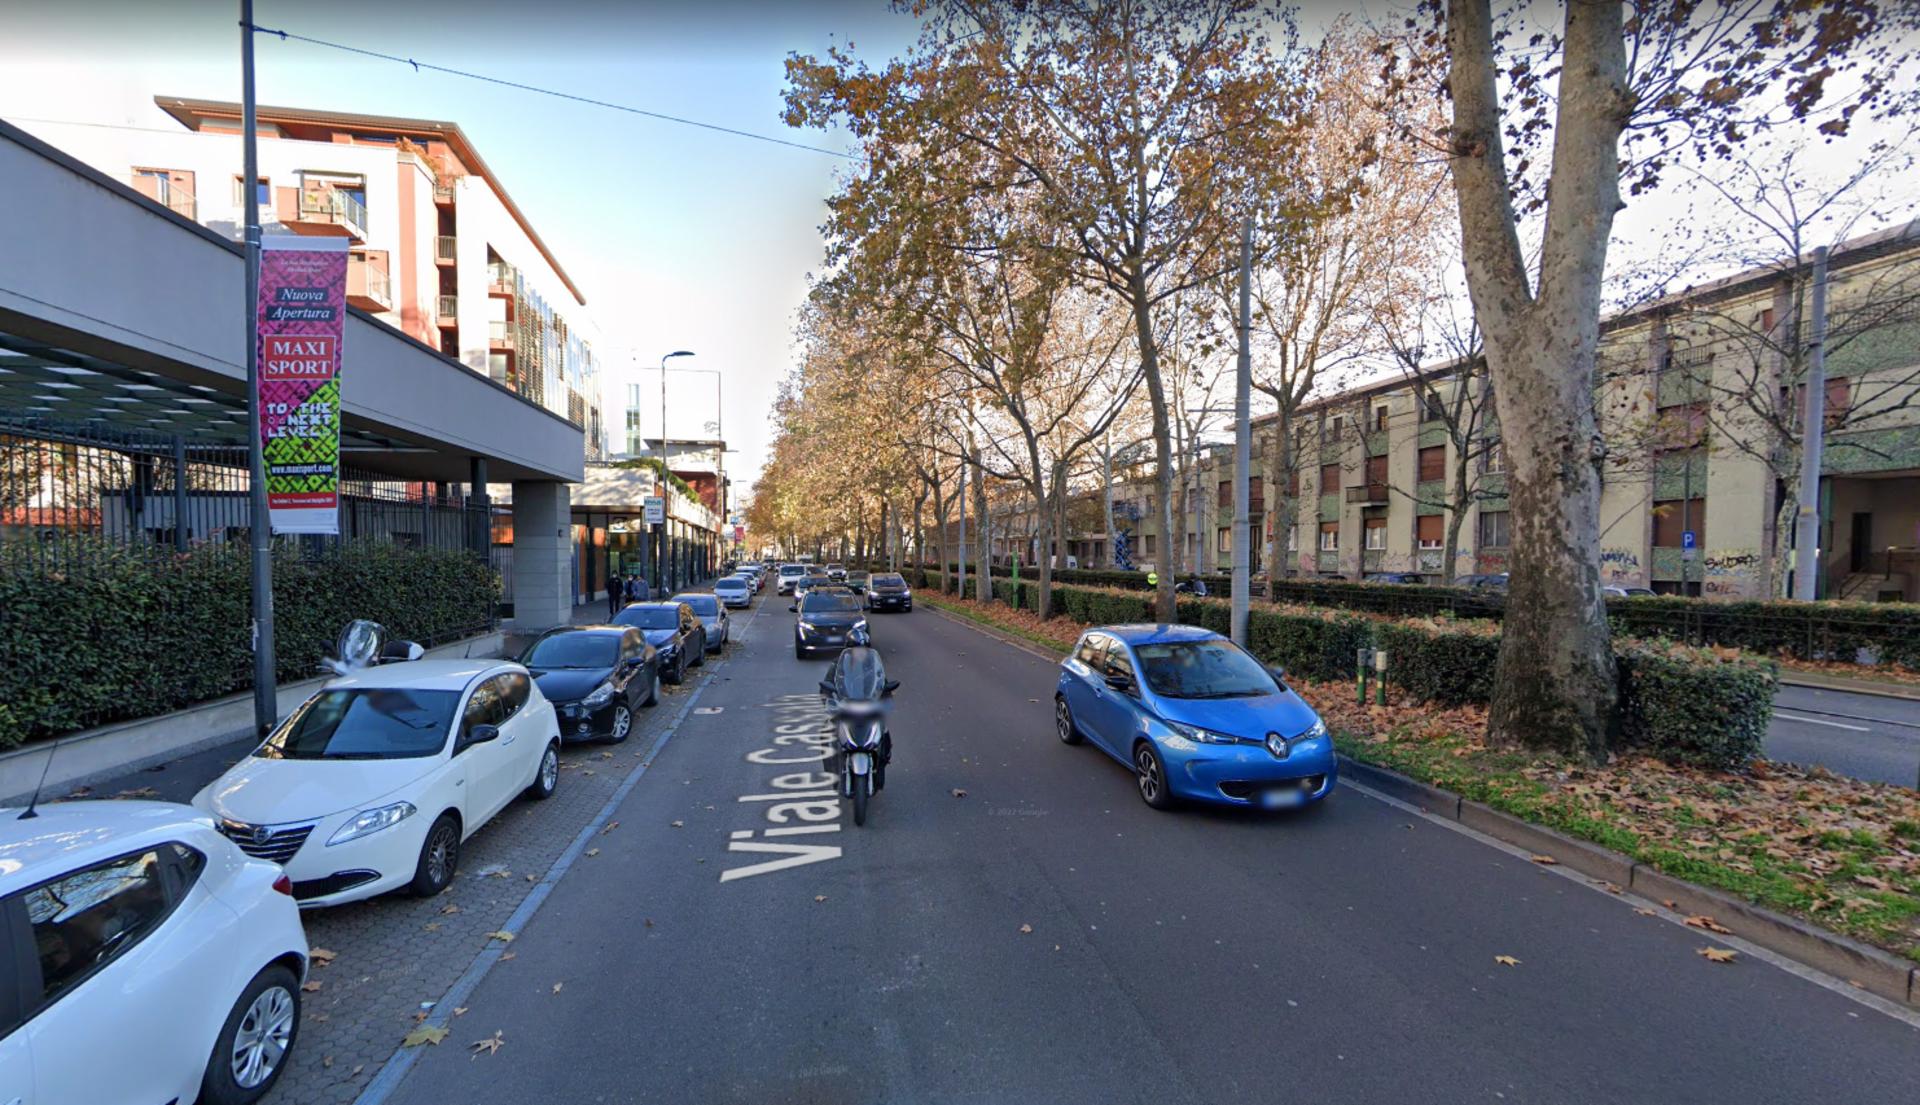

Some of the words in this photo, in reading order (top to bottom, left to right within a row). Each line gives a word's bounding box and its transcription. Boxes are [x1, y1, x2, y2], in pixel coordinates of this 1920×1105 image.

[281, 288, 324, 301] Nuova
[272, 306, 331, 321] Apertura
[273, 341, 327, 356] MAXI
[268, 359, 332, 375] SPORT
[267, 402, 288, 414] TO
[299, 402, 332, 414] THE
[287, 414, 332, 426] NEXT
[1684, 533, 1693, 547] P
